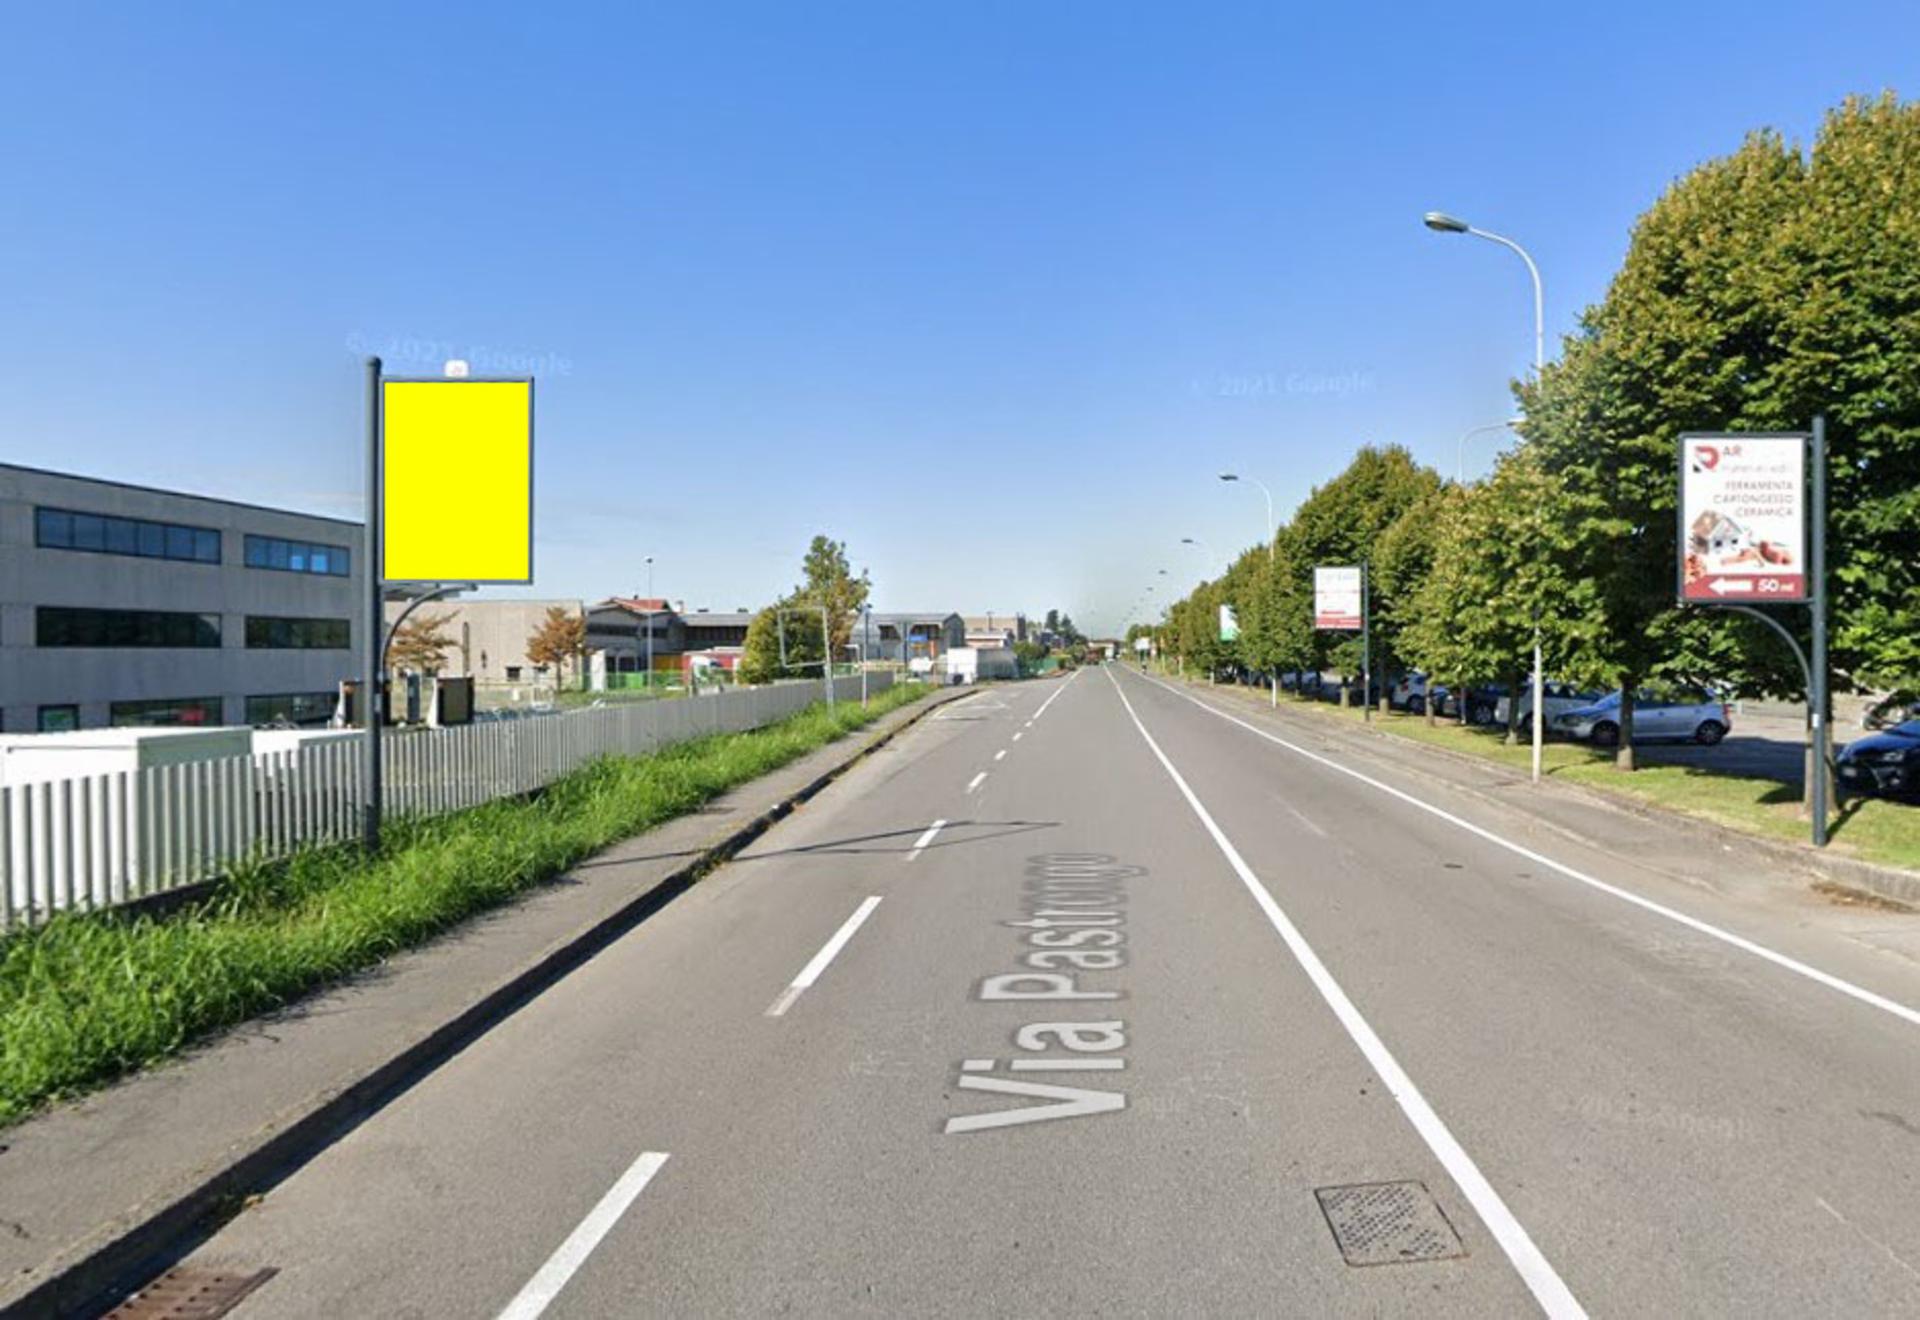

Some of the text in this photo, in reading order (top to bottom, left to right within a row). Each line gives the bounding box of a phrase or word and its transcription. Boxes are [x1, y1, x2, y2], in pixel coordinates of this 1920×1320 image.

[1725, 480, 1793, 491] FERRAMENTA
[1735, 507, 1793, 517] CERAMICA
[1758, 578, 1779, 592] 50
